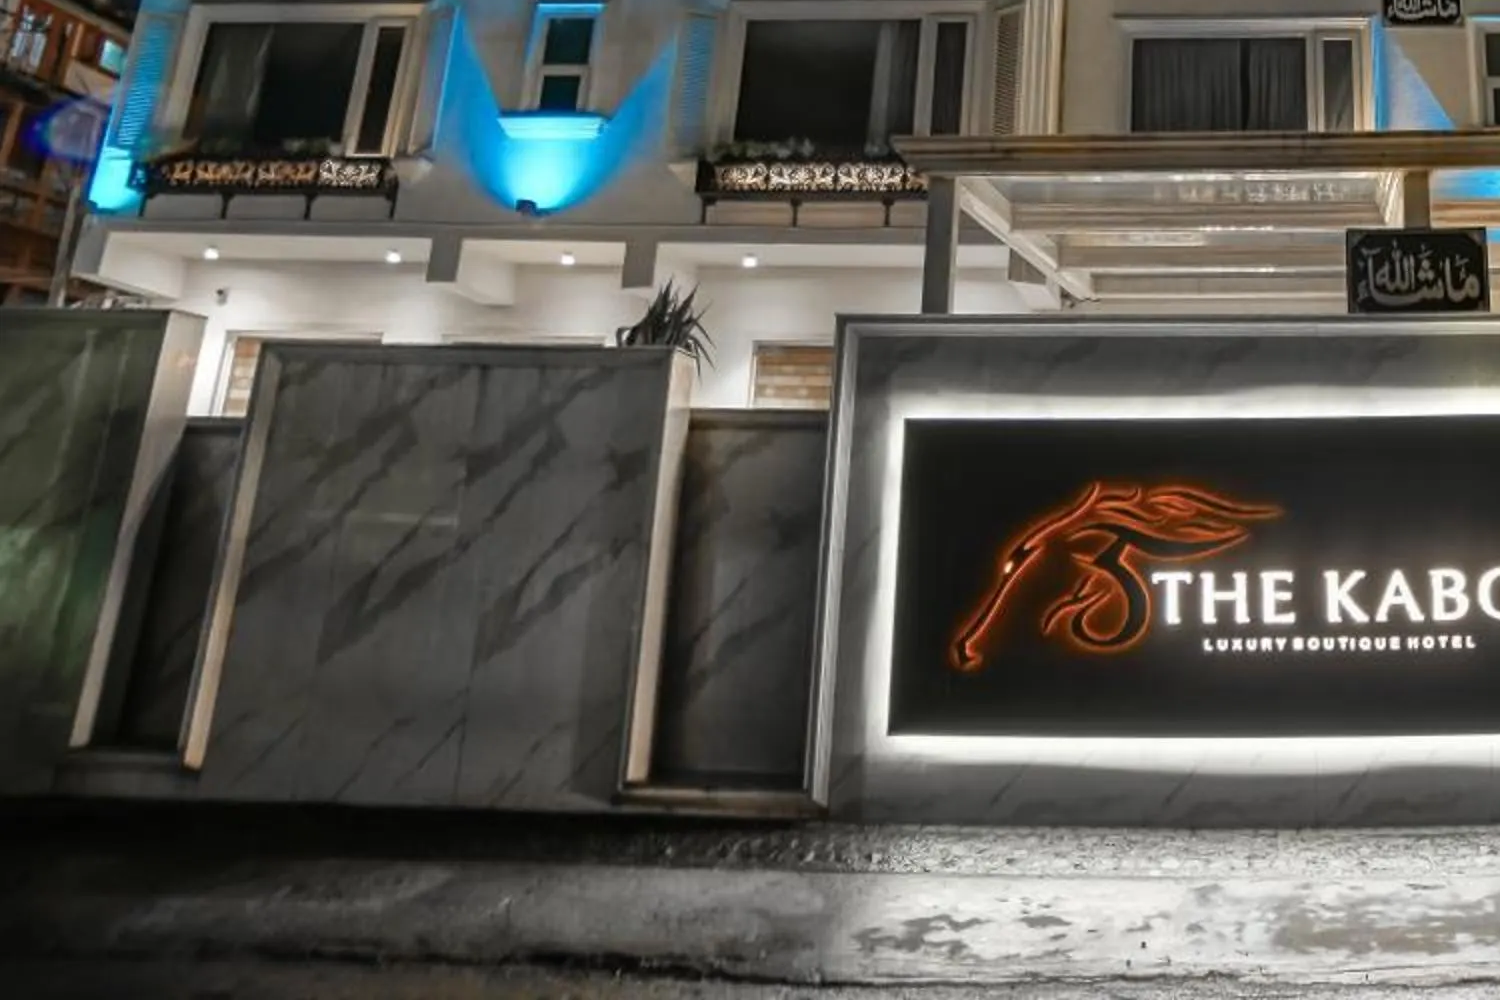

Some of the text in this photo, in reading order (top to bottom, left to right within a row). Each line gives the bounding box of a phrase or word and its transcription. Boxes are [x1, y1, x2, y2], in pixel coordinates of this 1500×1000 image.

[1150, 570, 1297, 626] THE
[1202, 634, 1476, 652] LUXURY BOUTIQUE HOTEL
